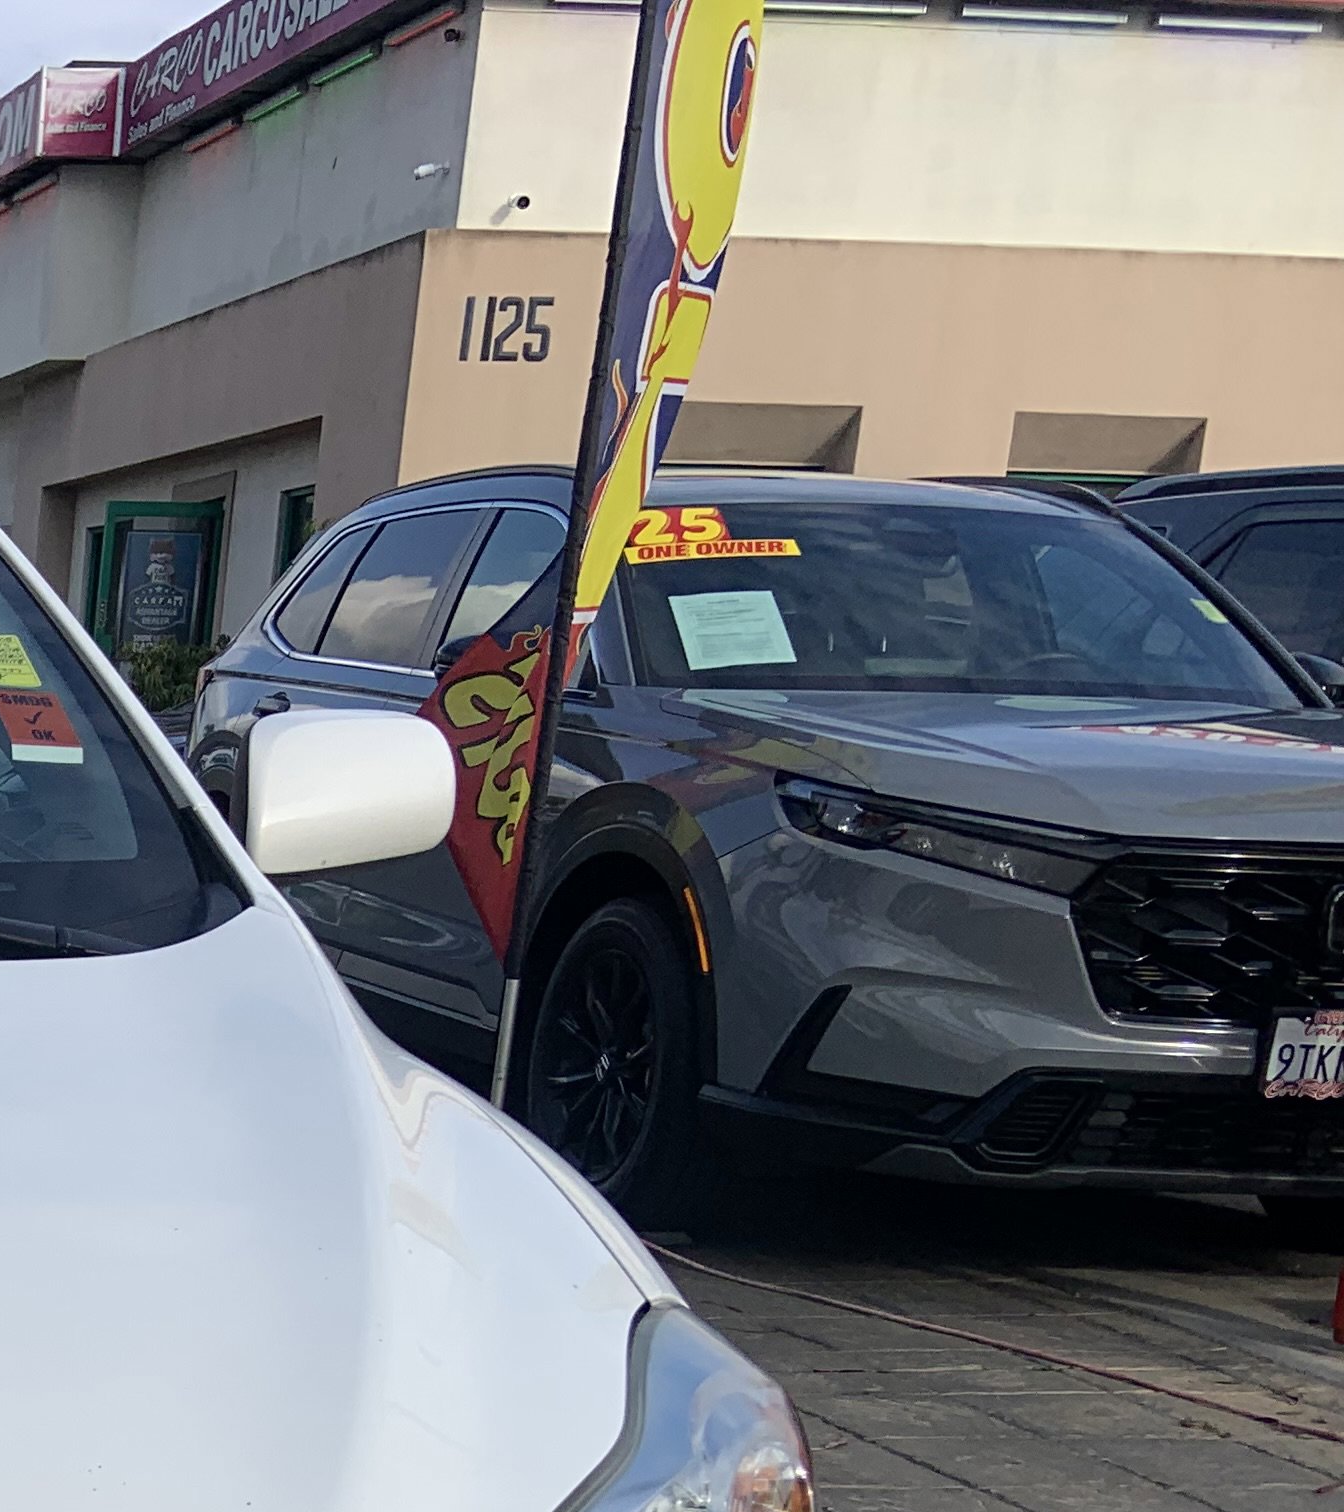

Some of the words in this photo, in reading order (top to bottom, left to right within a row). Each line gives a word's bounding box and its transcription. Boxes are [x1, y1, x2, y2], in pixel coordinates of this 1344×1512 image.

[129, 28, 204, 118] CARCO
[458, 295, 556, 363] 1125
[637, 544, 689, 561] ONE
[696, 540, 785, 556] OWNER
